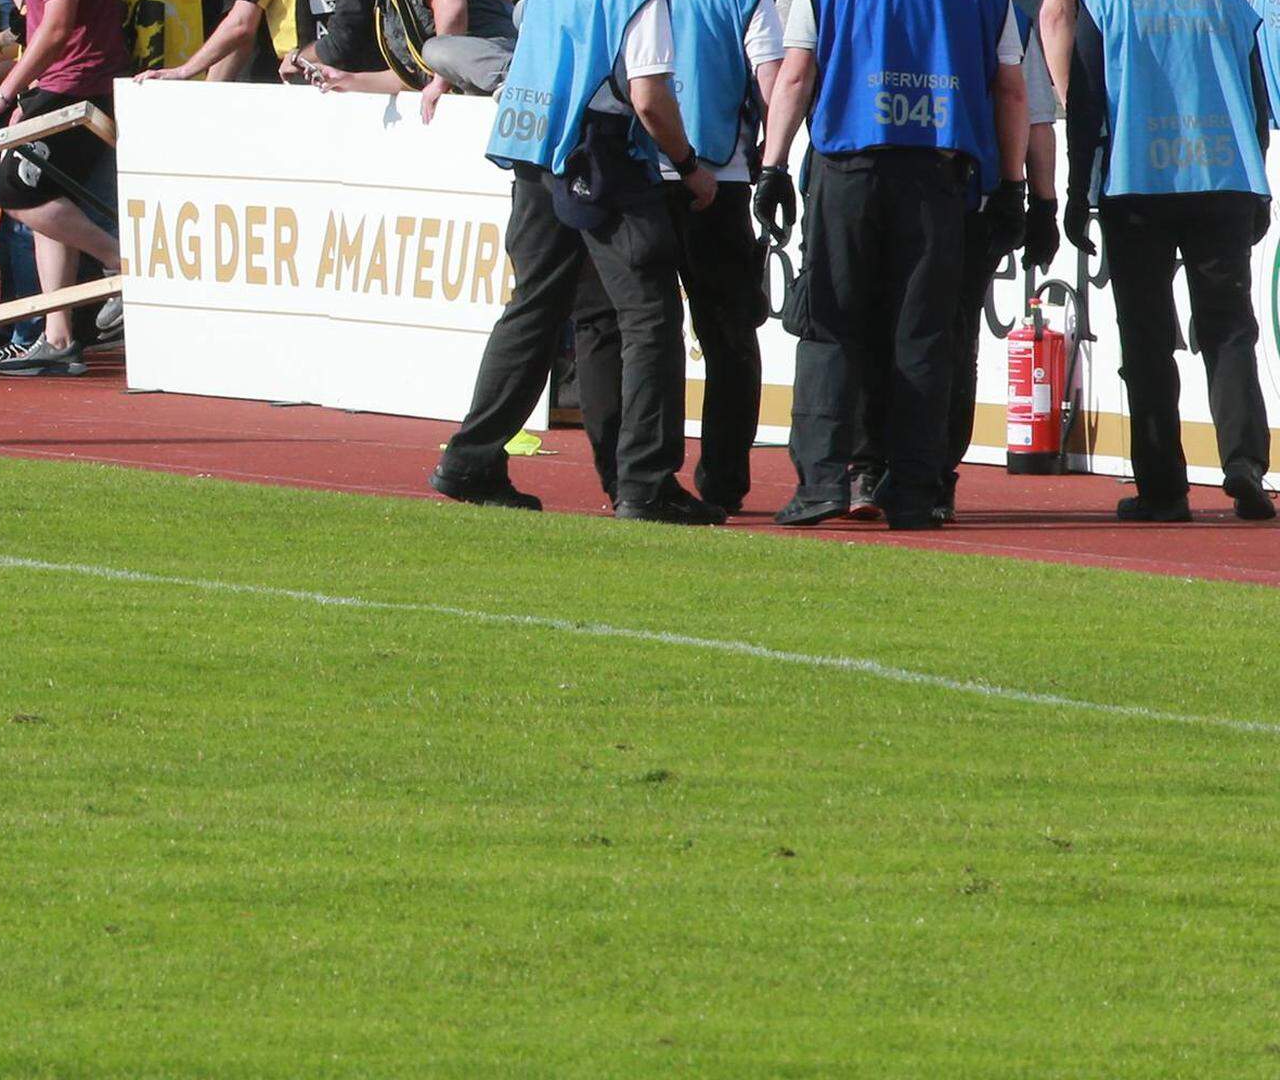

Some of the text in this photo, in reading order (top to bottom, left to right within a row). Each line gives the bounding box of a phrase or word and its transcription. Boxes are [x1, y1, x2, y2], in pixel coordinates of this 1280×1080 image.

[867, 72, 960, 91] SUPERVISOR
[874, 91, 952, 129] S045
[213, 203, 300, 287] DER
